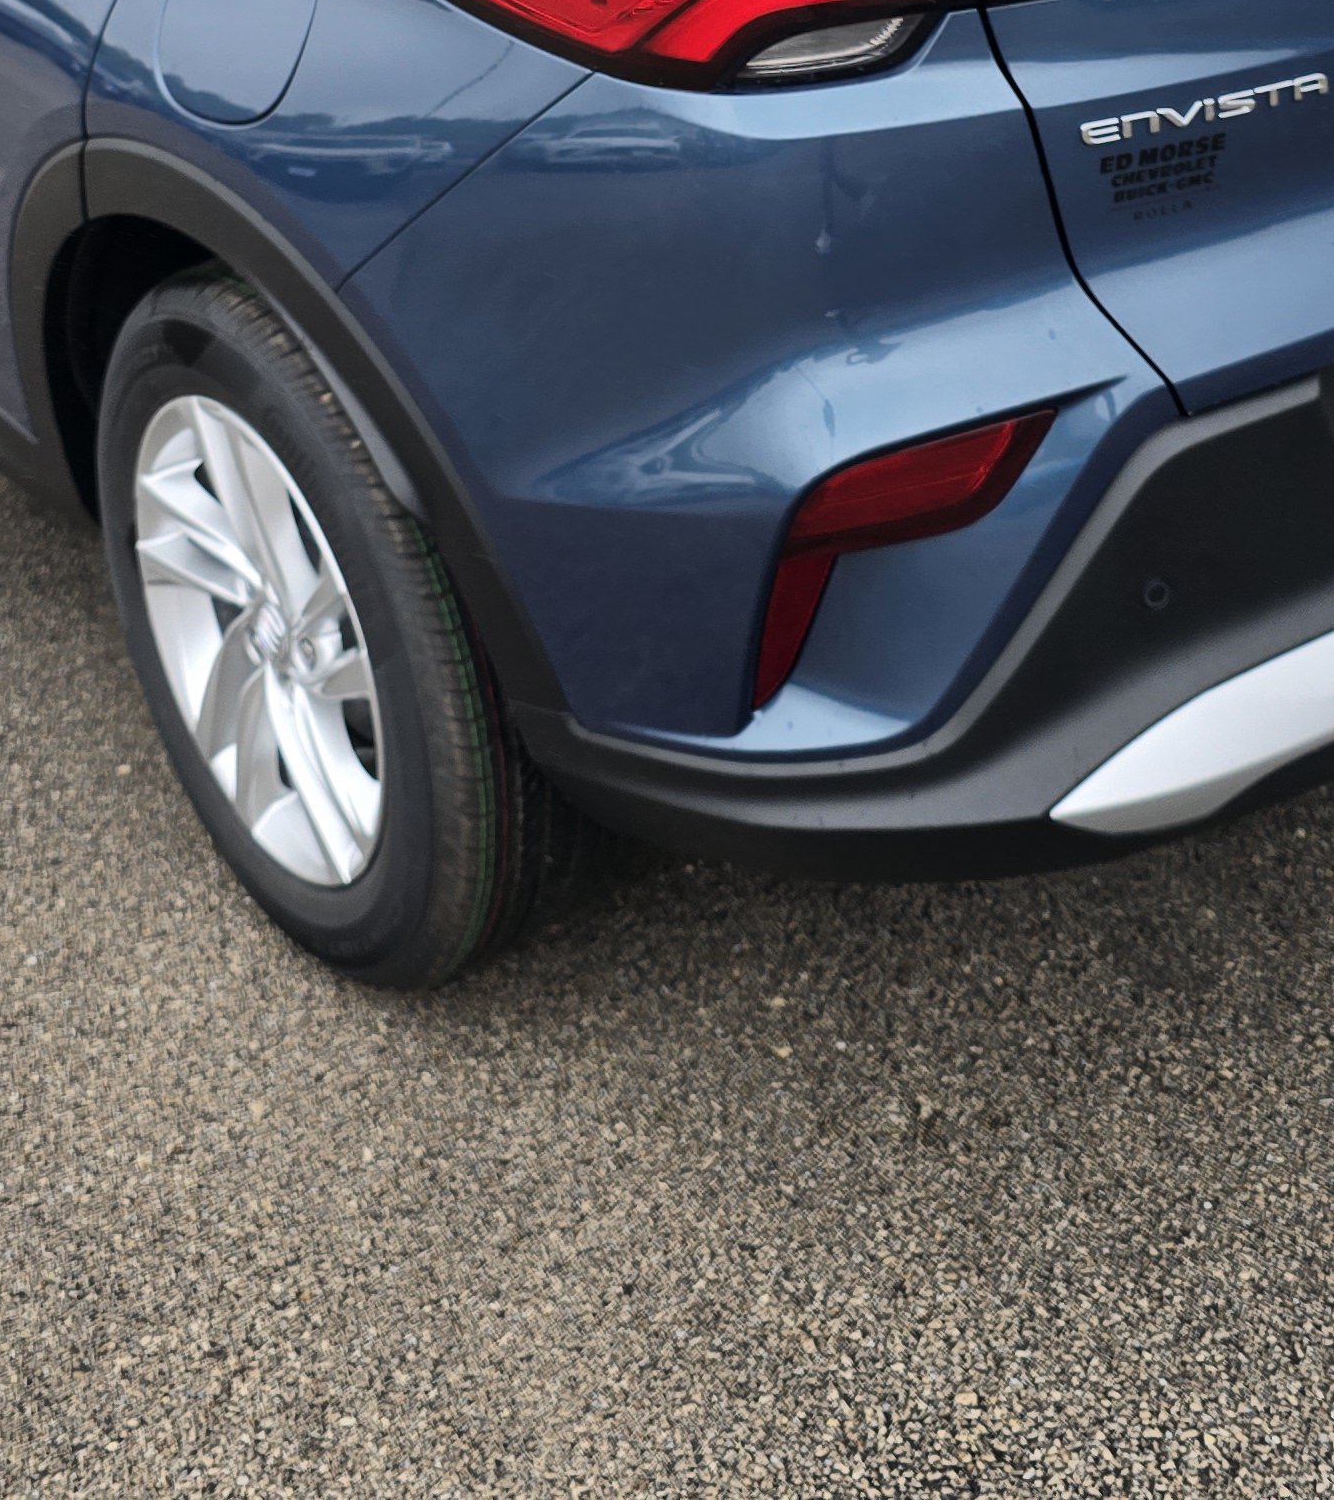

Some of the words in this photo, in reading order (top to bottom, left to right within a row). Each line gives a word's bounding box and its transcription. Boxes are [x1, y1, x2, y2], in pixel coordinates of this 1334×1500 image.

[1079, 72, 1330, 145] ENVISTA
[1099, 153, 1133, 175] ED
[1138, 132, 1227, 167] MORSE
[1110, 155, 1218, 188] CHEVROLET
